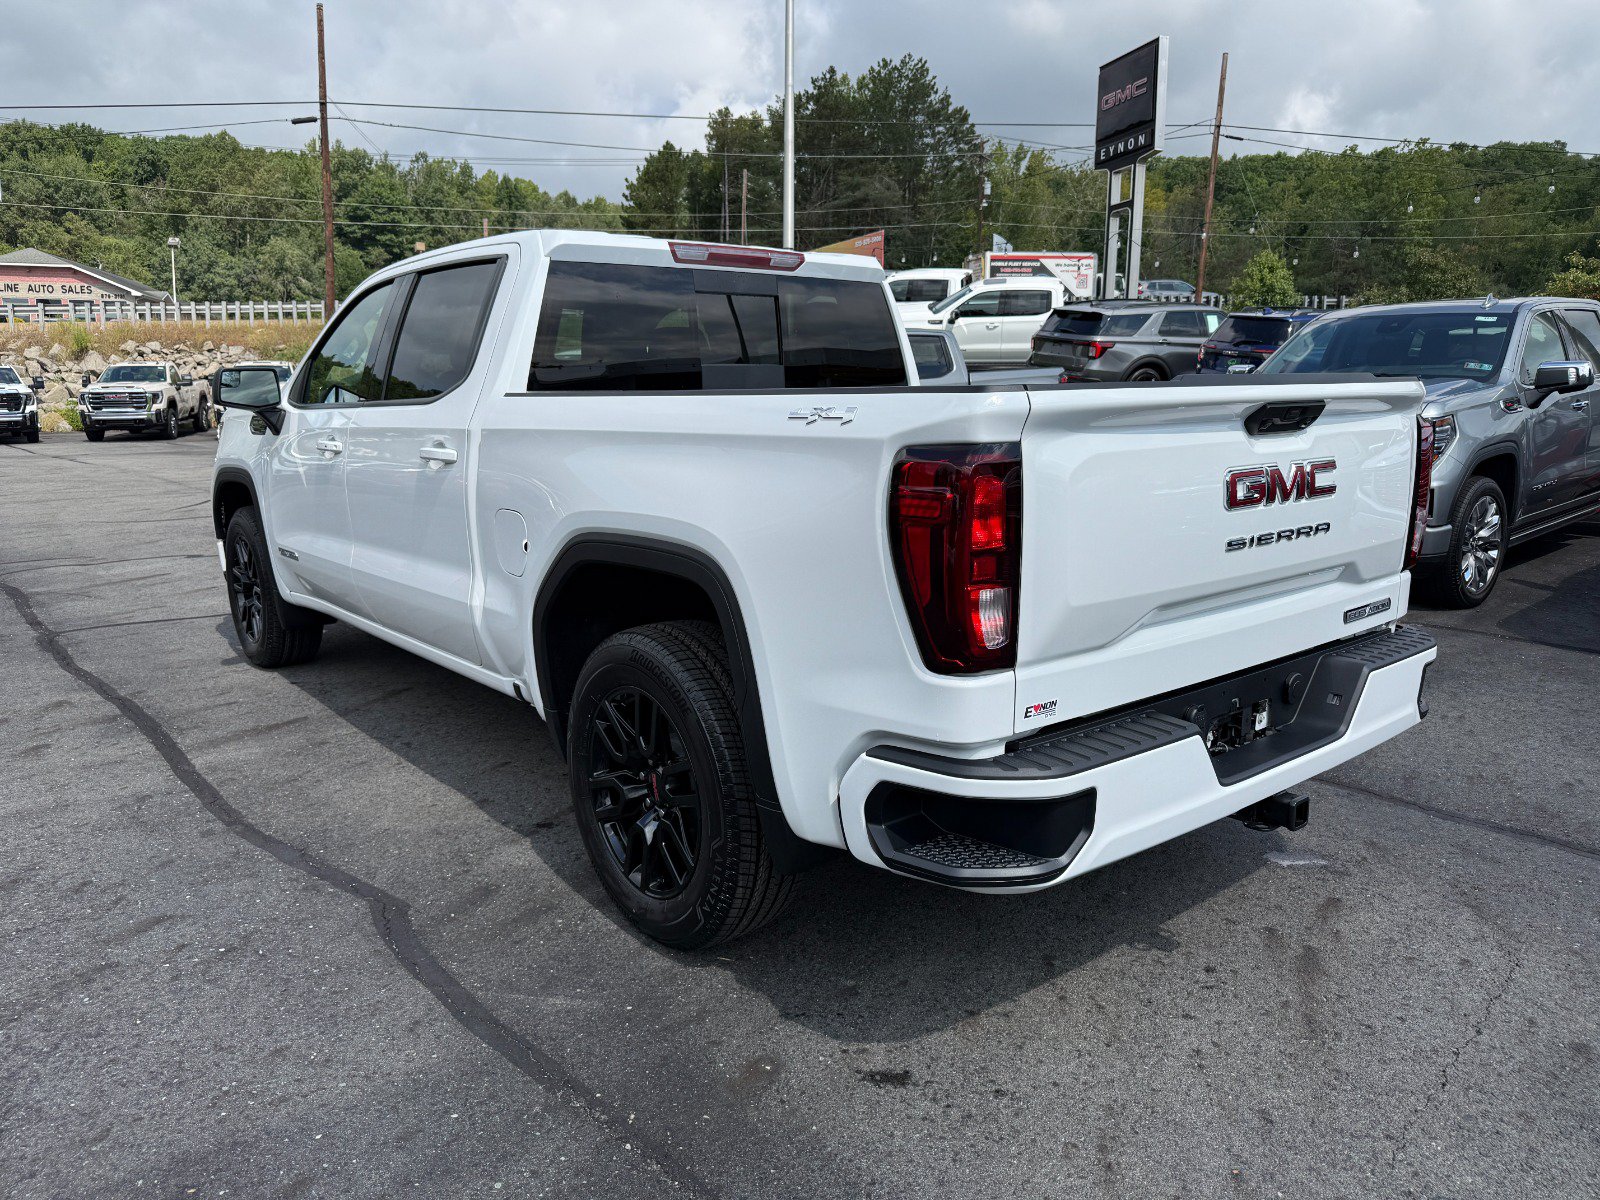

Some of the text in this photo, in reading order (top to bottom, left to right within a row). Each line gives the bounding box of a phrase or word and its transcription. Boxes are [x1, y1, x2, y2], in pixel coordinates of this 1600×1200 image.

[1101, 77, 1148, 111] GMC
[1100, 133, 1145, 160] EYNON
[27, 285, 54, 294] AUTO
[61, 285, 93, 295] SALES
[1224, 457, 1337, 512] GMC
[1225, 521, 1331, 553] SIERRA
